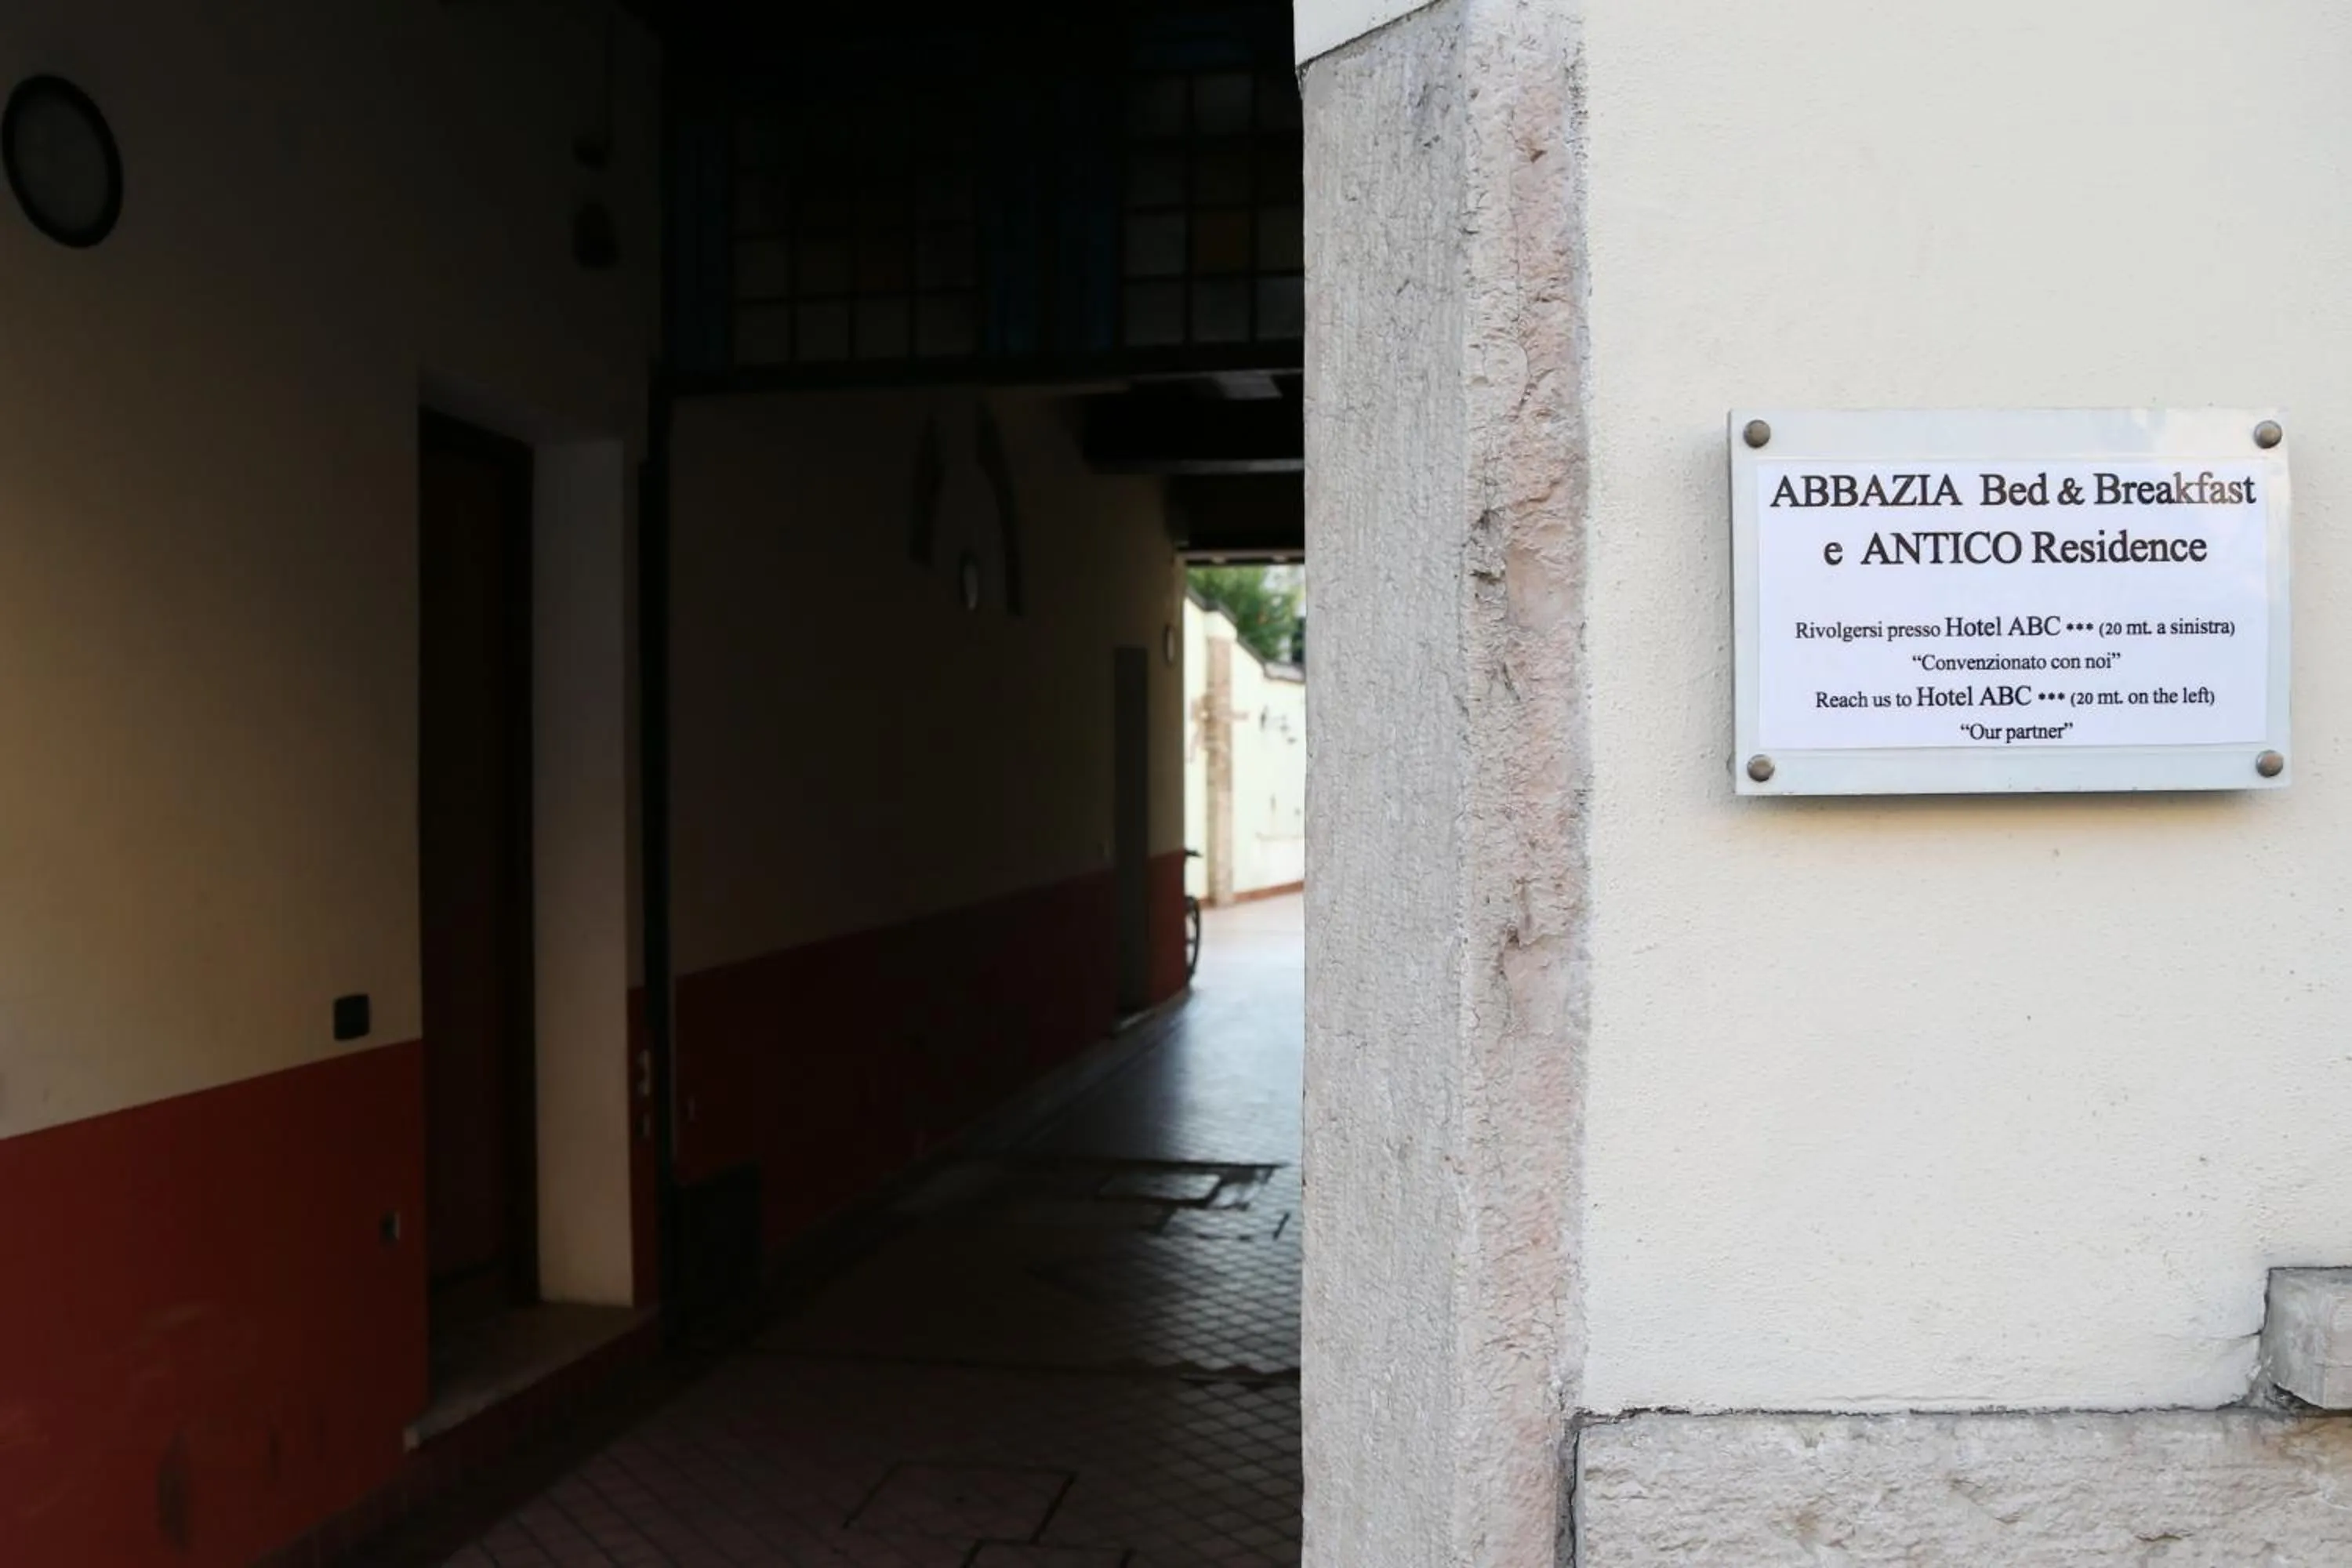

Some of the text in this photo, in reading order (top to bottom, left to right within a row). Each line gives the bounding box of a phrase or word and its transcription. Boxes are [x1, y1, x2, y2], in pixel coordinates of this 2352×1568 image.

[1769, 471, 2256, 507] ABBAZIA Bed & Breakfast
[1824, 529, 2207, 566] e ANTICO Residence
[1795, 615, 2236, 642] Rivolgersi presso Hotel ABC (20 mt. a sinistra)
[2050, 656, 2082, 670] con
[1815, 685, 2216, 708] Reach us to Hotel ABC (20 mt. on the left)
